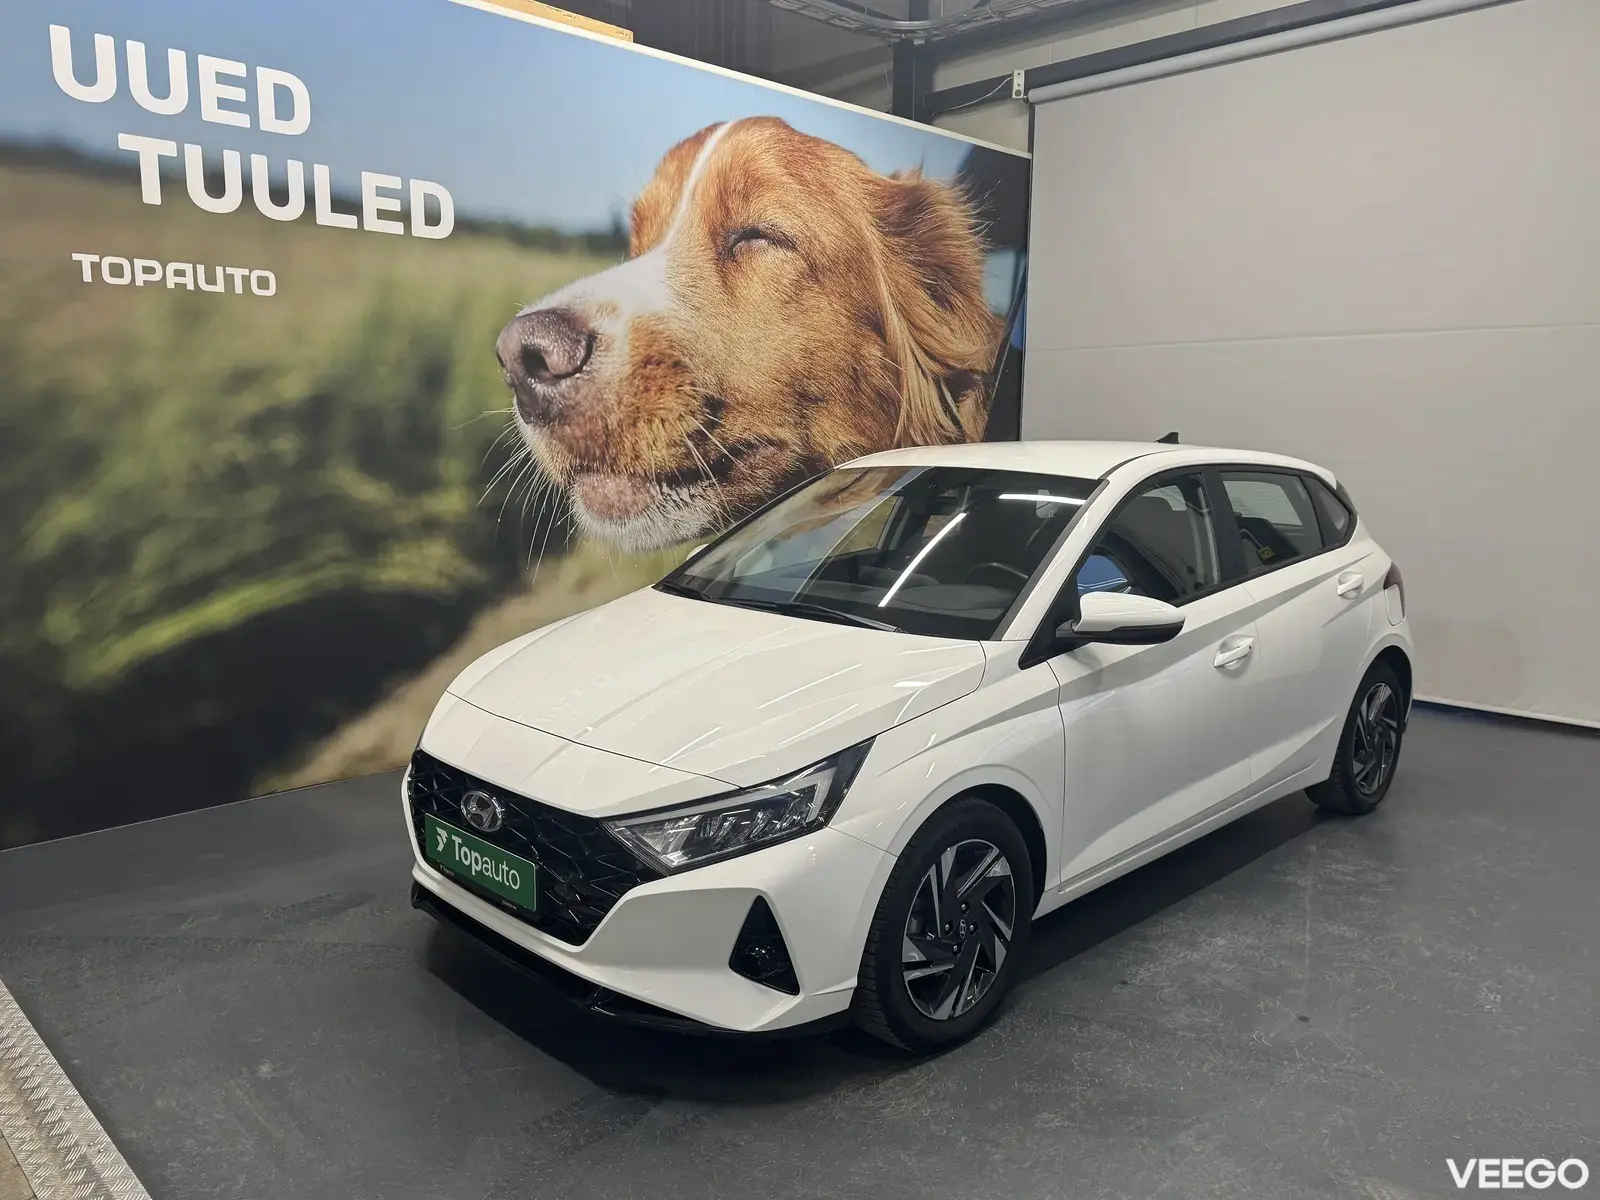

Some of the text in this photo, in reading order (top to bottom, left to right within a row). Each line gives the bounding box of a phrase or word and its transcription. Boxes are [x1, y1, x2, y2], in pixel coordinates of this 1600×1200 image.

[49, 24, 311, 136] UUED
[117, 132, 455, 239] TUULED
[72, 252, 277, 297] TOPAUTO
[451, 834, 520, 890] Topauto
